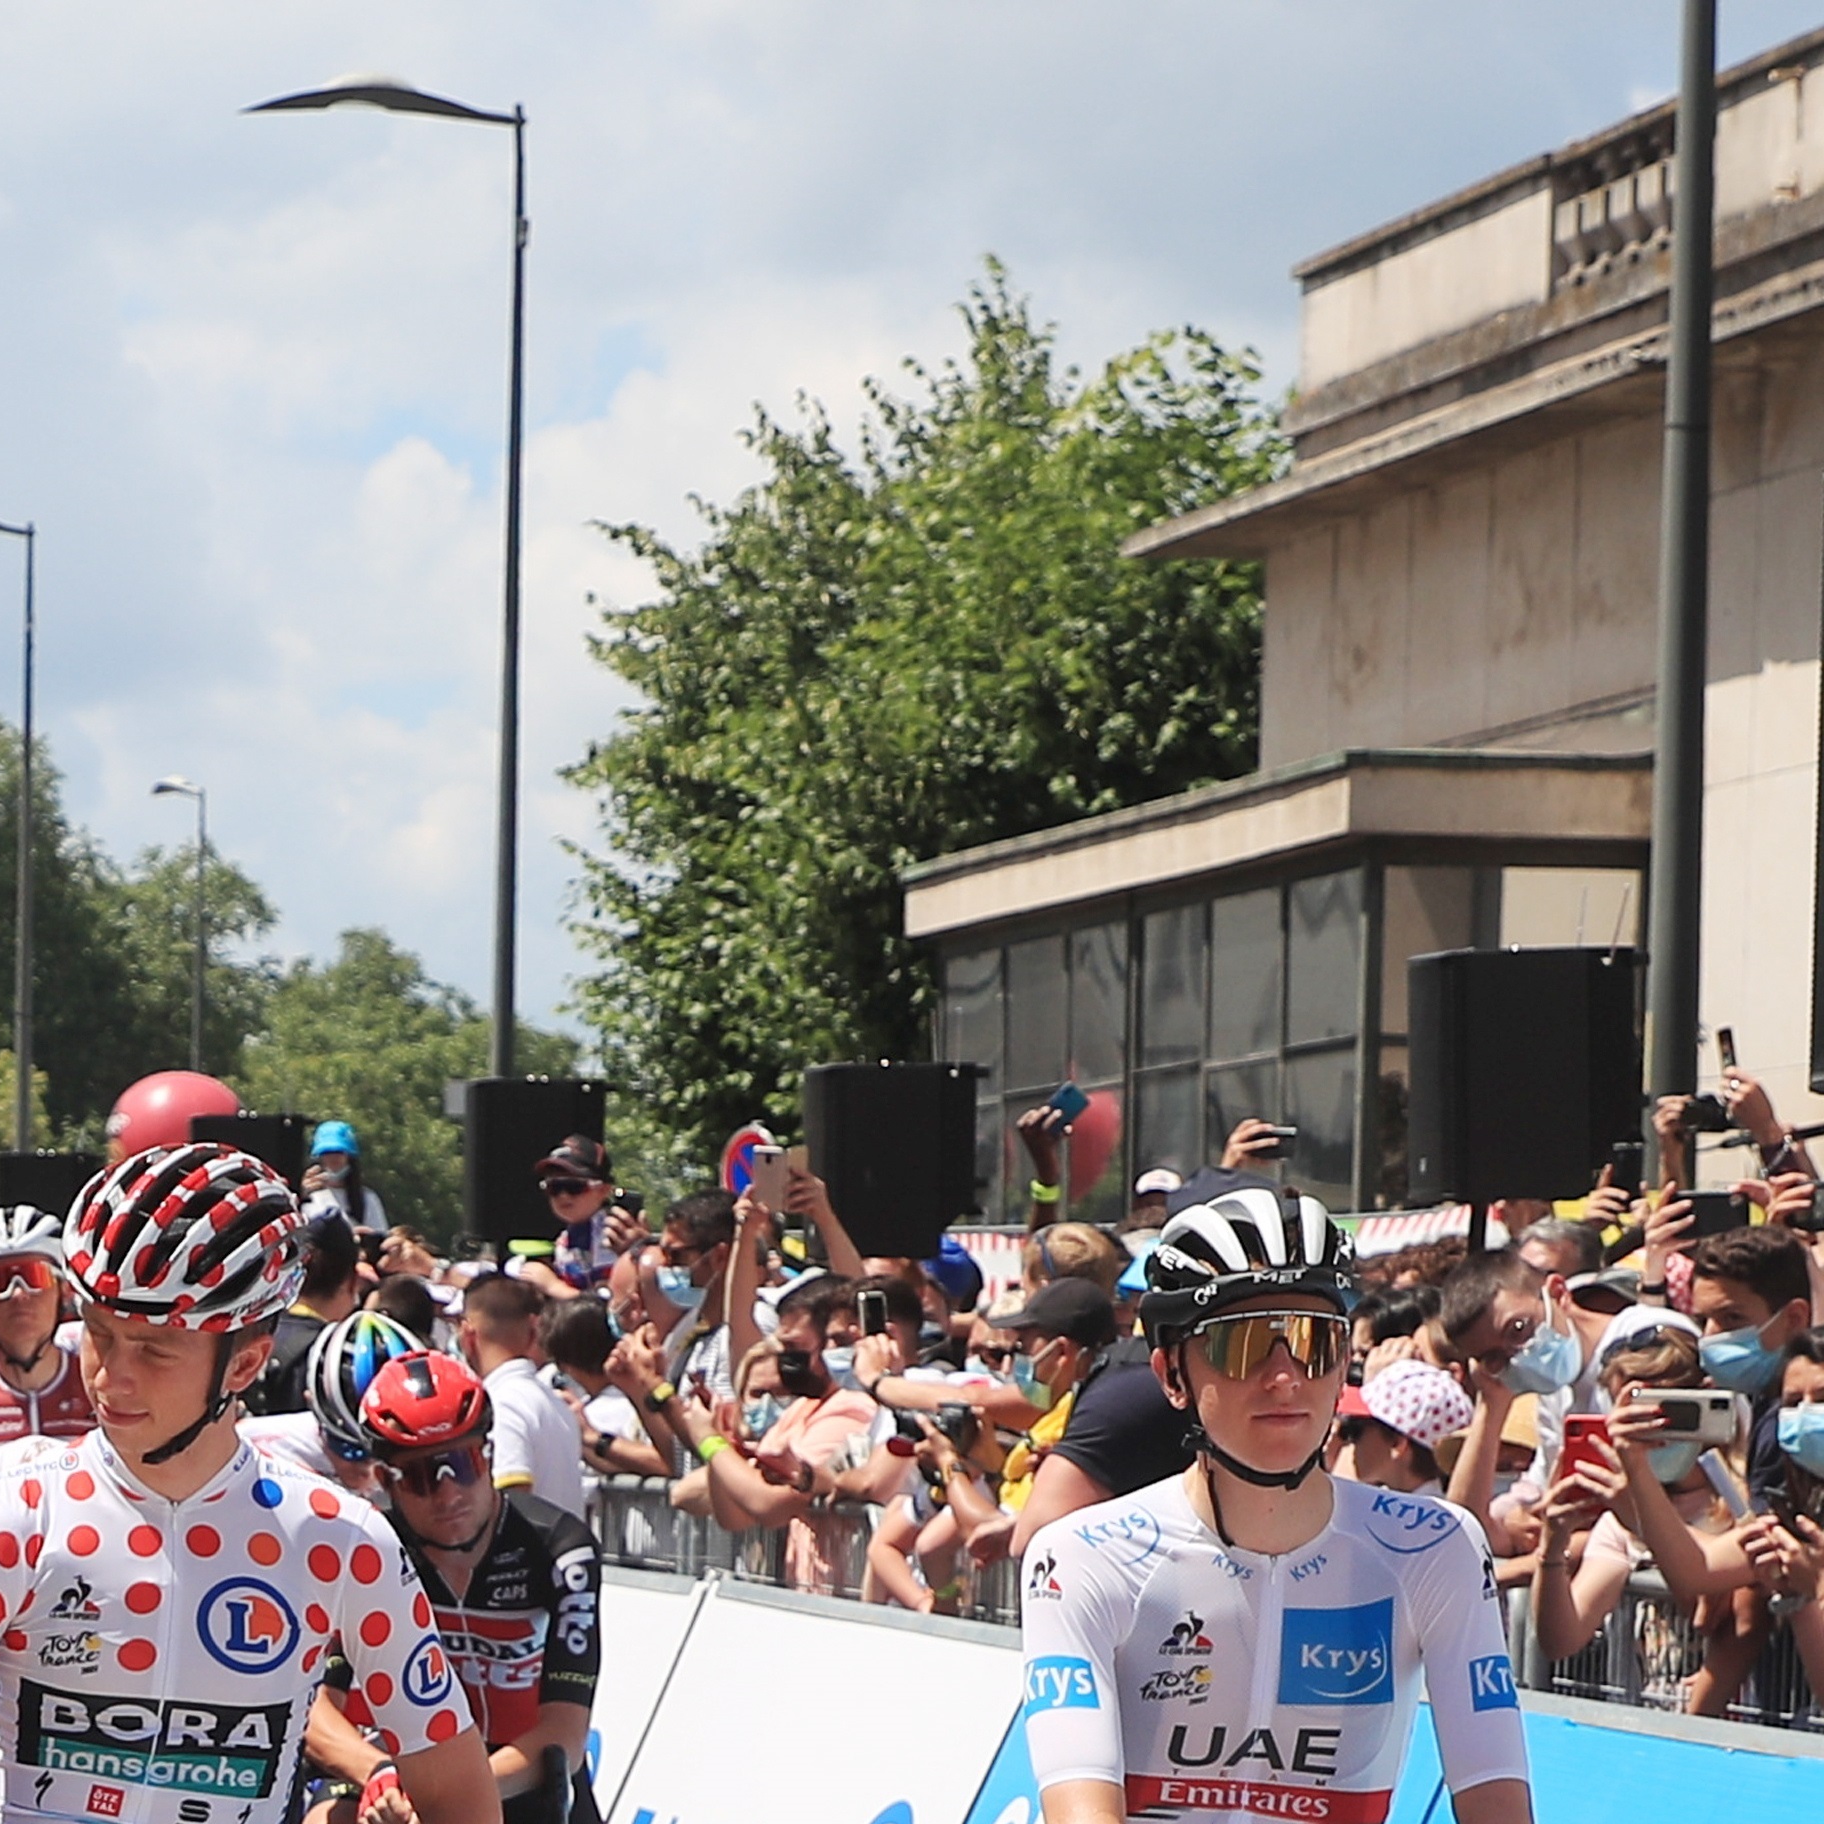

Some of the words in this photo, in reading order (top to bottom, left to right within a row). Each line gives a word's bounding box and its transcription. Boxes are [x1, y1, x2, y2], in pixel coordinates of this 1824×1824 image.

[1076, 1511, 1148, 1549] Krys
[1371, 1494, 1454, 1532] Krys
[1212, 1554, 1254, 1583] Krys
[1289, 1554, 1328, 1583] Krys
[1301, 1643, 1383, 1677] Krys
[40, 1696, 273, 1750] BORA
[45, 1745, 258, 1788] hansgrohe
[1167, 1726, 1344, 1777] UAE
[1159, 1778, 1331, 1820] Emirates
